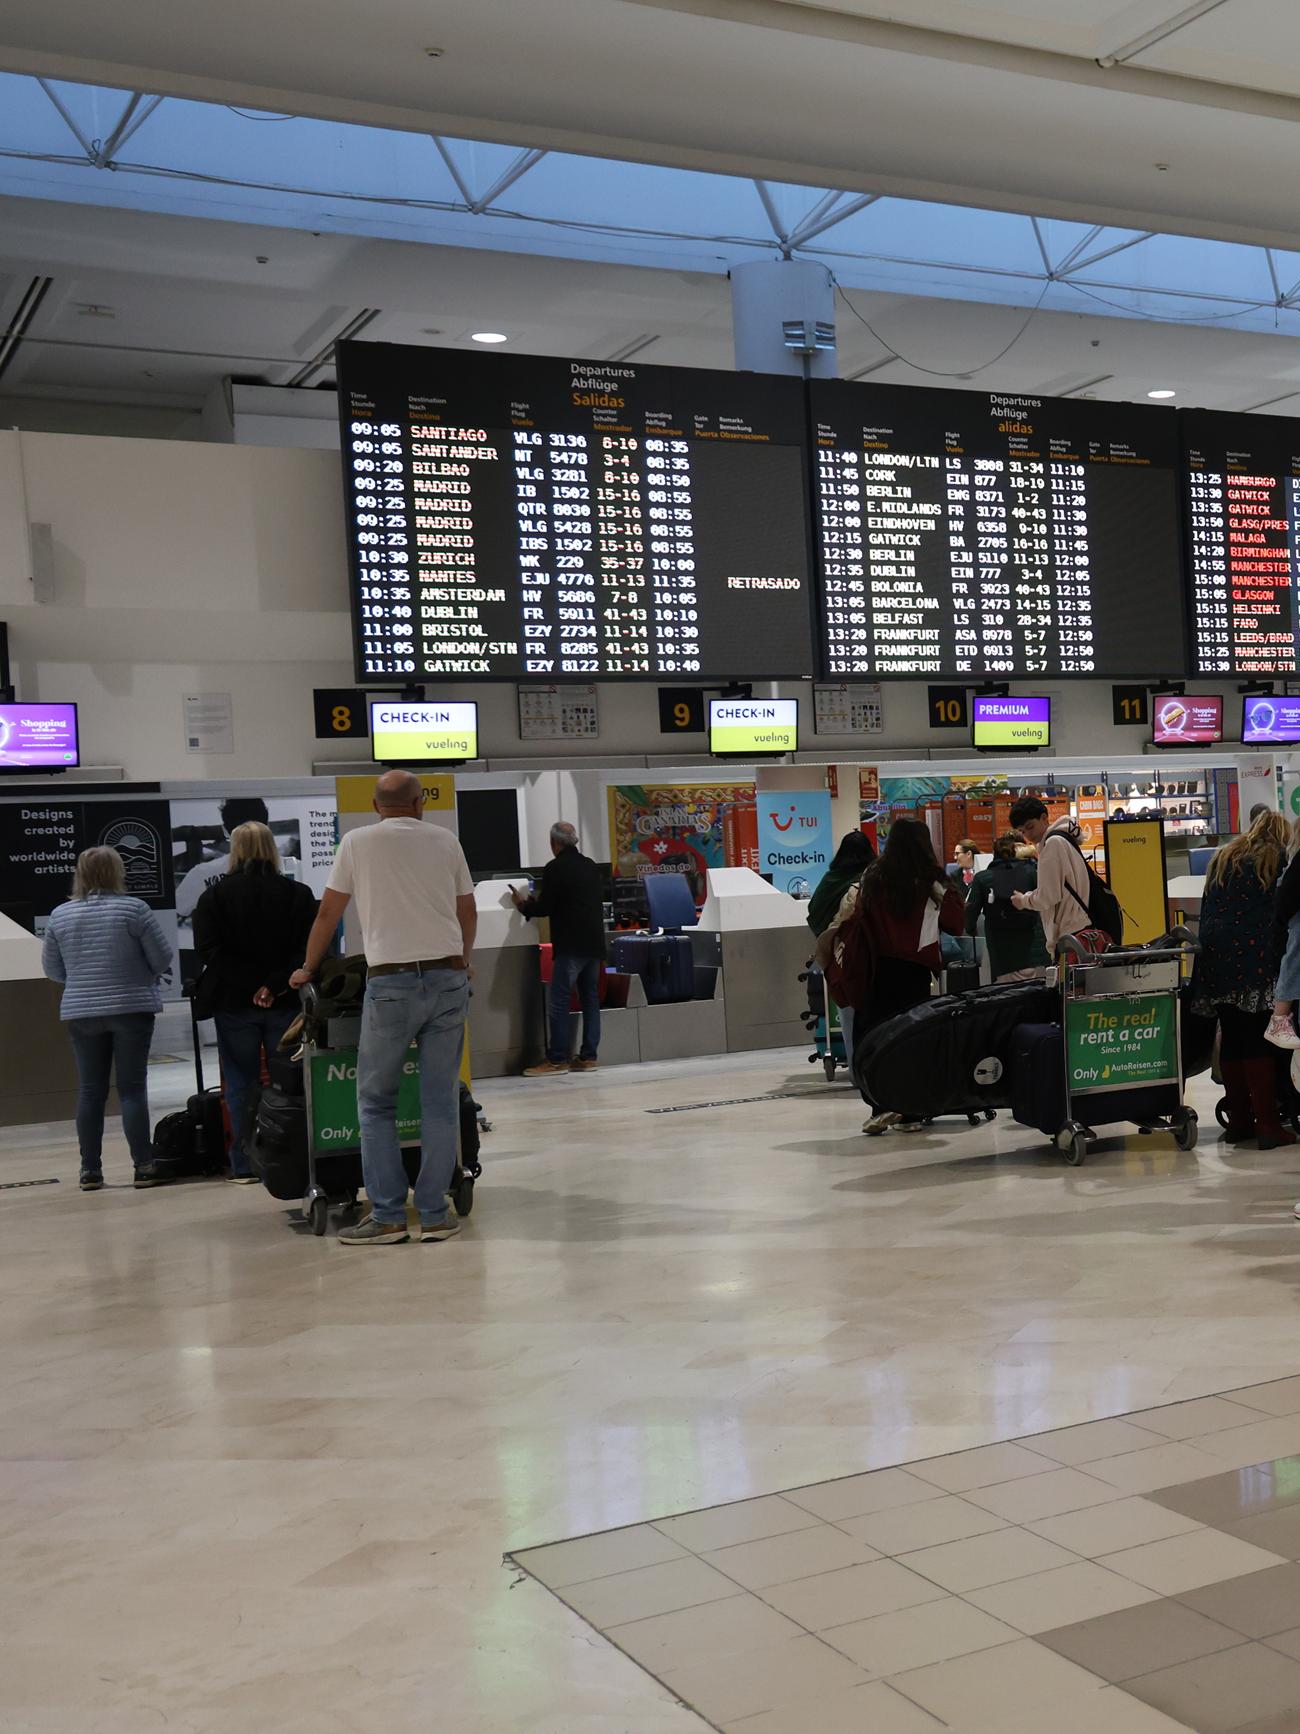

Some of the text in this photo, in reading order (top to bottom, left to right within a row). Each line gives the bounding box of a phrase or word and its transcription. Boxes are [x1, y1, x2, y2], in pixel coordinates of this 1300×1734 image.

[571, 363, 636, 378] Departures
[571, 378, 618, 392] Abflüge
[573, 392, 625, 408] Salidas
[990, 394, 1042, 408] Departures
[990, 407, 1028, 420] Abflüge
[352, 422, 486, 441] 09:05 SANTIAGO
[353, 441, 498, 460] 09:05 SANTANDER
[819, 451, 939, 468] 11:40 LONDON/LTN
[354, 459, 469, 476] 09:20 BILBAO
[820, 467, 896, 481] 11:45 CORK
[1190, 473, 1221, 484] 13:25
[355, 477, 470, 494] 09:25 MADRID
[821, 483, 911, 498] 11:50 BERLIN
[1191, 487, 1222, 498] 13:30
[356, 496, 471, 511] 09:25 MADRID
[821, 499, 941, 514] 12:00 E.MIDLANDS
[1192, 502, 1222, 513] 13:35
[357, 514, 472, 529] 09:25 MADRID
[822, 515, 935, 530] 12:00 EINDHOVEN
[1192, 516, 1223, 527] 13:50
[358, 532, 473, 547] 09:25 MADRID
[823, 532, 921, 545] 12:15 GATWICK
[1193, 531, 1224, 541] 14:15
[824, 548, 914, 561] 12:30 BERLIN
[1194, 545, 1224, 556] 14:20
[359, 550, 475, 565] 10:30 ZURICH
[825, 564, 915, 576] 12:35 DUBLIN
[1194, 560, 1225, 570] 14:55
[361, 569, 801, 591] 10:35 NANTES RETRASADO
[826, 580, 923, 592] 12:45 BOLONIA
[1195, 574, 1226, 585] 15:00
[362, 587, 505, 601] 10:35 AMSTERDAM
[1196, 589, 1226, 599] 15:05
[827, 597, 939, 608] 13:05 BARCELONA
[1196, 603, 1227, 613] 15:15
[363, 605, 478, 618] 10:40 DUBLIN
[827, 613, 923, 624] 13:05 BELFAST
[1197, 618, 1228, 628] 15:15
[364, 624, 488, 636] 11:00 BRISTOL
[828, 629, 939, 640] 13:20 FRANKFURT
[1198, 632, 1228, 642] 15:15
[365, 642, 517, 656] 11:05 LONDON/STN
[829, 645, 940, 655] 13:20 FRANKFURT
[1198, 647, 1229, 656] 15:25
[366, 660, 490, 672] 11:10 GATWICK
[830, 661, 941, 672] 13:20 FRANKFURT
[1199, 661, 1230, 671] 15:30
[673, 703, 690, 727] 9
[716, 708, 776, 719] CHECK-IN
[935, 700, 961, 722] 10
[979, 704, 1029, 716] PREMIUM
[1120, 699, 1142, 720] 11
[20, 719, 67, 728] Shopping
[331, 705, 351, 732] 8
[380, 712, 450, 723] CHECK-IN
[754, 731, 790, 745] vueling
[1011, 727, 1043, 740] vueling
[425, 738, 468, 751] vueling
[21, 809, 73, 822] Designs
[799, 816, 817, 827] TUI
[24, 825, 74, 835] created
[59, 838, 75, 848] by
[1122, 836, 1146, 844] vueling
[9, 851, 76, 862] worldwide
[767, 852, 825, 865] Check-in
[34, 864, 77, 874] artists
[1087, 1007, 1156, 1029] The real
[1080, 1026, 1161, 1045] rent a car
[1100, 1043, 1141, 1054] Since 1984
[1073, 1067, 1099, 1080] Only
[1111, 1060, 1168, 1072] AutoReisen.com
[320, 1126, 353, 1140] Only
